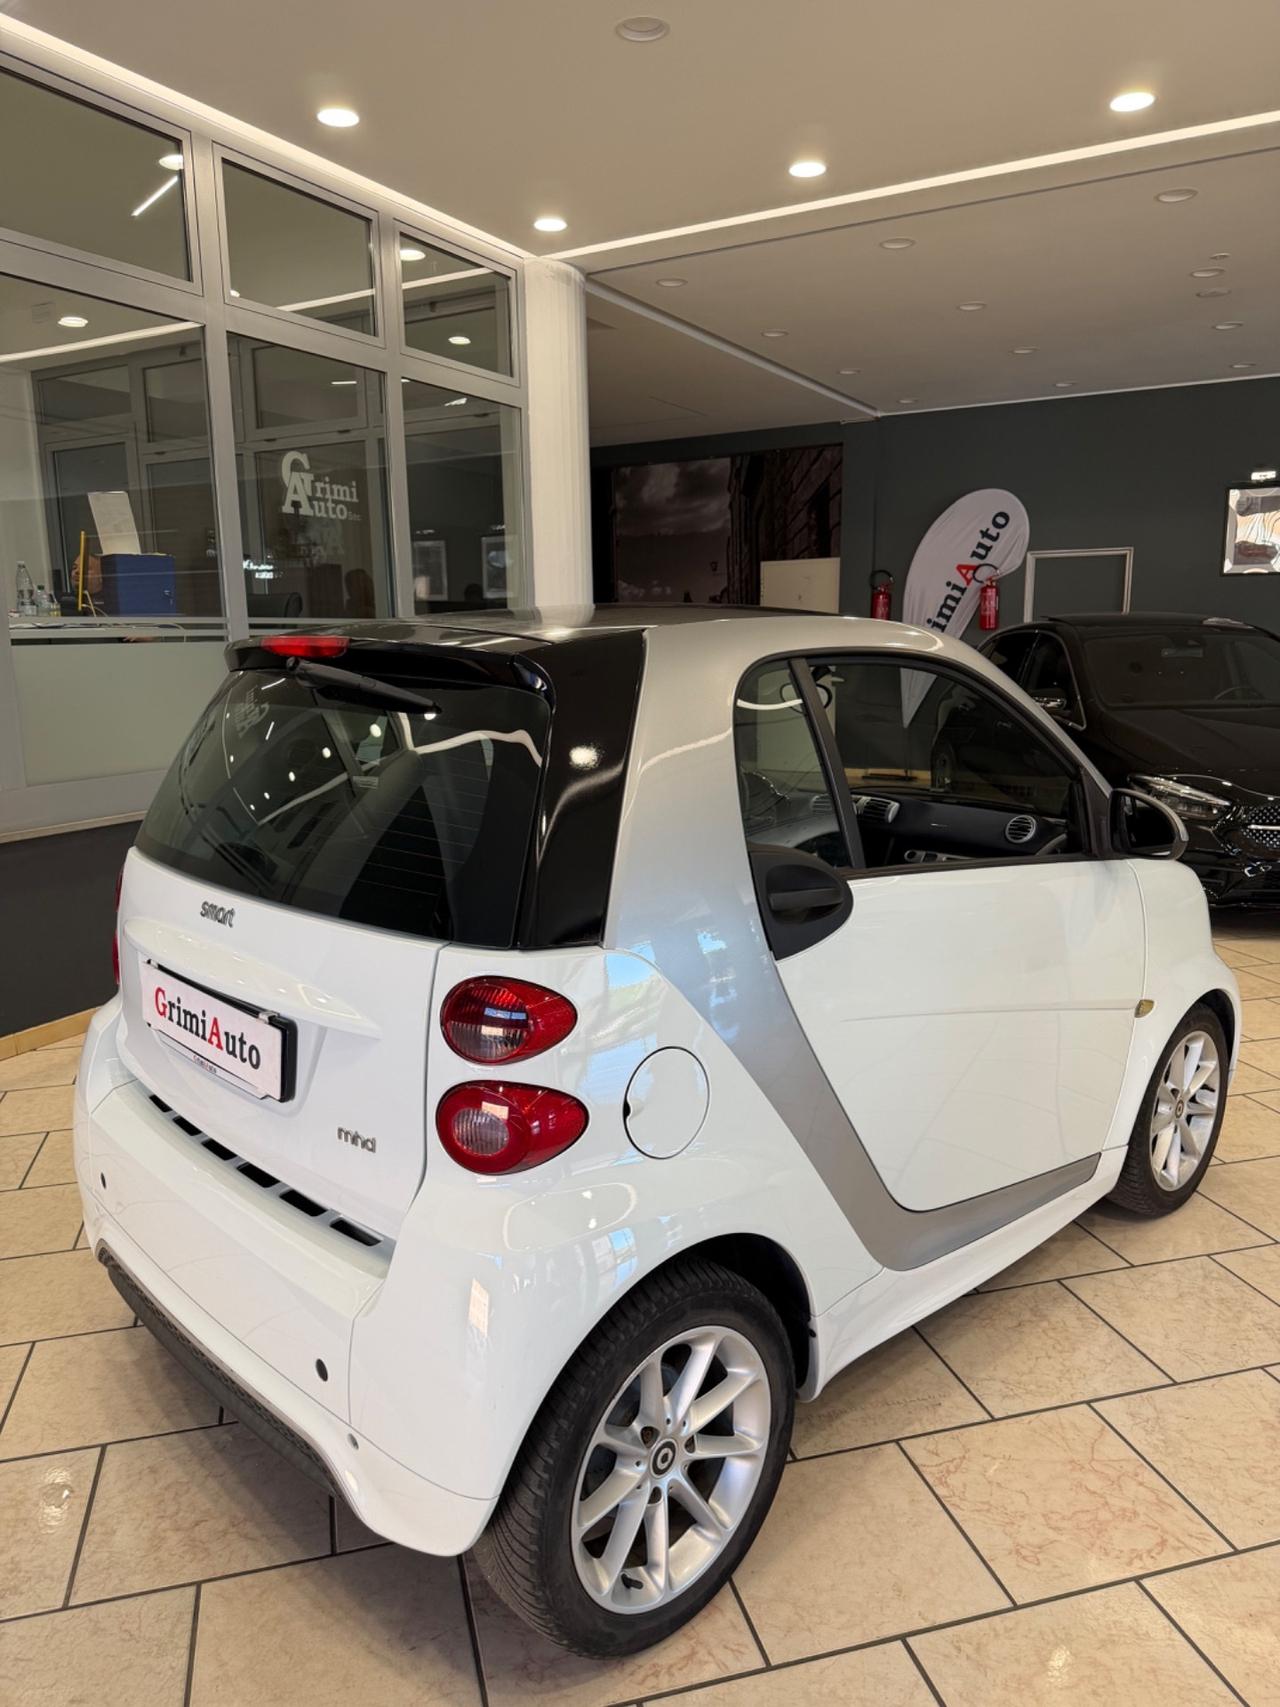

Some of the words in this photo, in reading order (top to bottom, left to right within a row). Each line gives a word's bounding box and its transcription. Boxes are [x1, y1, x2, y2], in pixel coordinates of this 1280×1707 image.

[282, 451, 359, 503] Grimi
[282, 472, 347, 520] Auto
[200, 901, 235, 928] smart
[155, 987, 261, 1070] GrimiAuto
